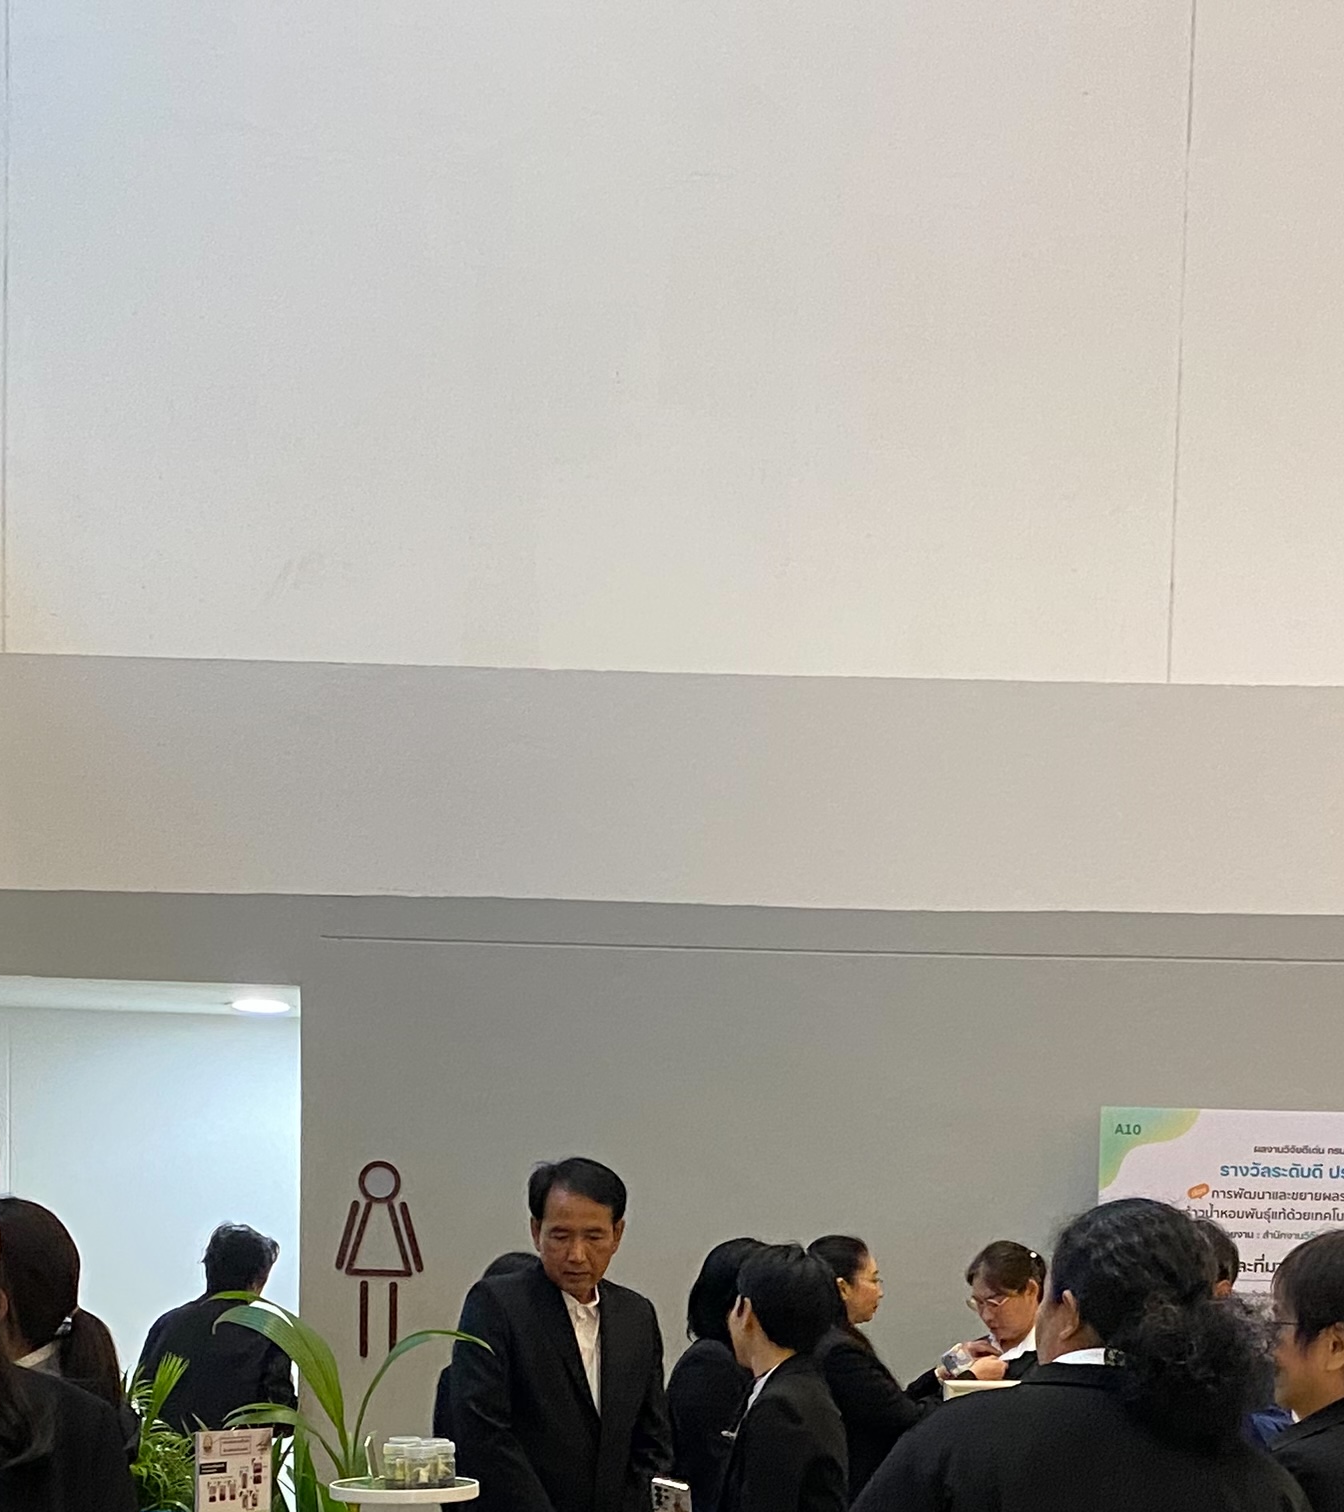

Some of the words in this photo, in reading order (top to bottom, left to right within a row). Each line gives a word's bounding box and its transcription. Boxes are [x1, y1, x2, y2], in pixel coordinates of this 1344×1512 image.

[1115, 1123, 1142, 1136] A10
[1253, 1144, 1325, 1155] ผลงานวิจัยดีเด่น
[1220, 1162, 1323, 1180] รางวัลระดับดี
